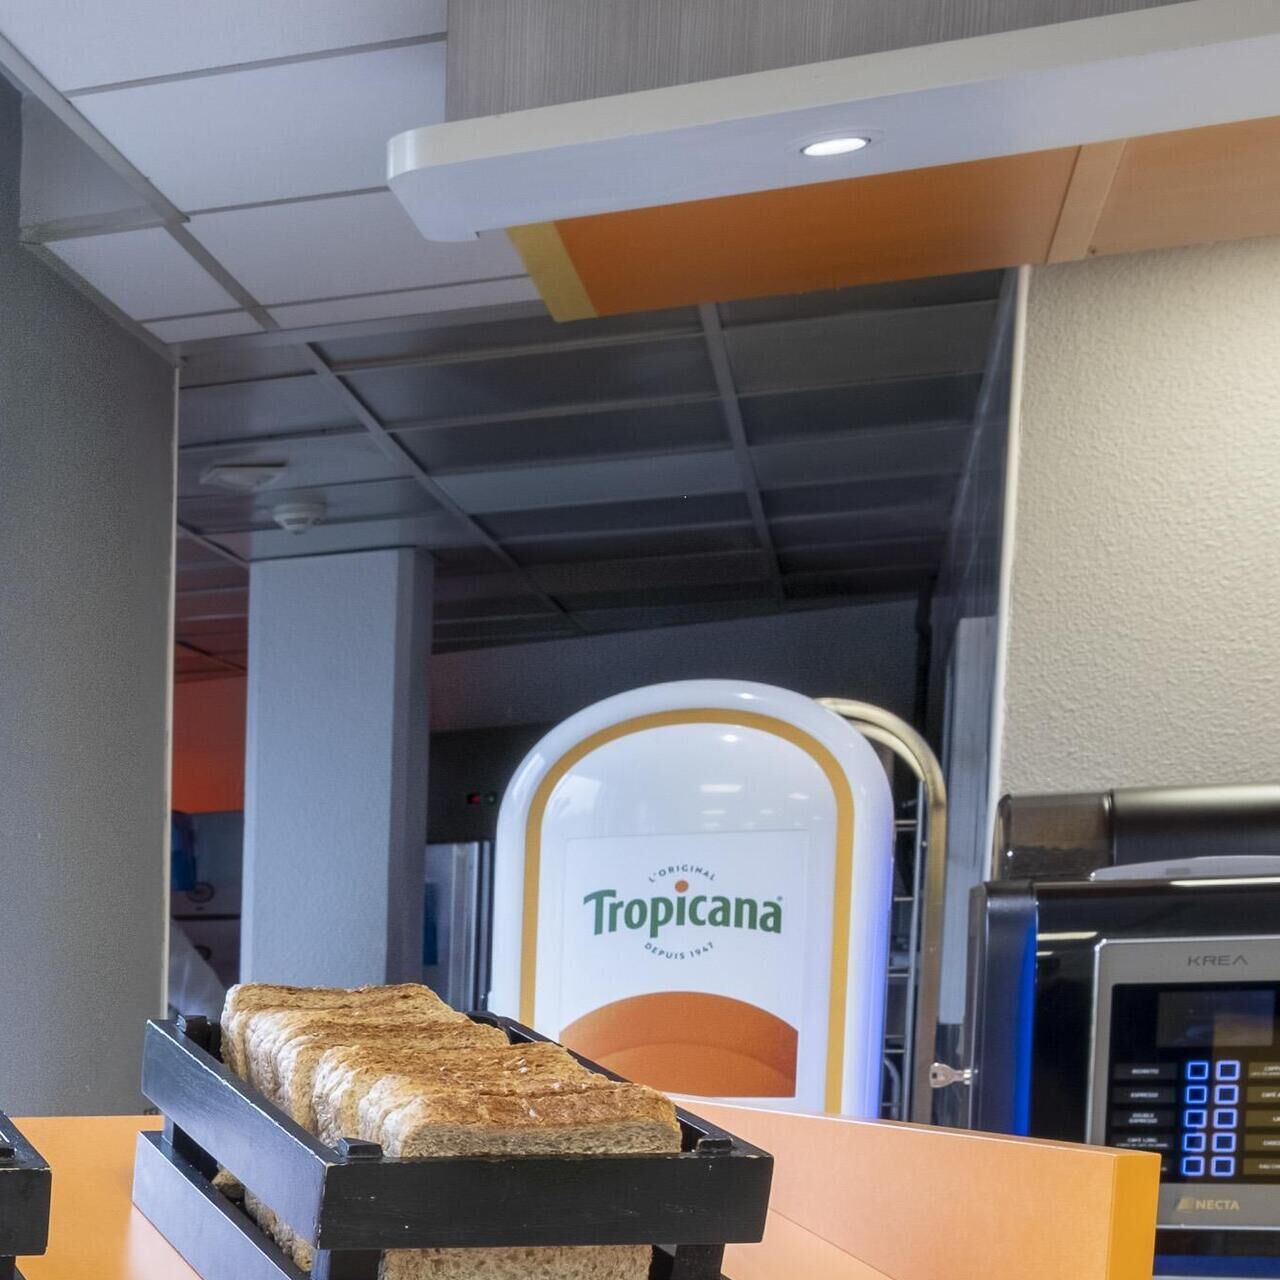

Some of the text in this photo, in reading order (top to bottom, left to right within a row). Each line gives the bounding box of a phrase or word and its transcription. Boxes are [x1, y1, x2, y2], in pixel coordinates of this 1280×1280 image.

[648, 864, 715, 882] L'ORIGINAL
[583, 880, 782, 938] Tropicana
[644, 942, 685, 959] DEPUIS
[1187, 954, 1248, 966] KREA
[1195, 1200, 1240, 1211] NECTA
